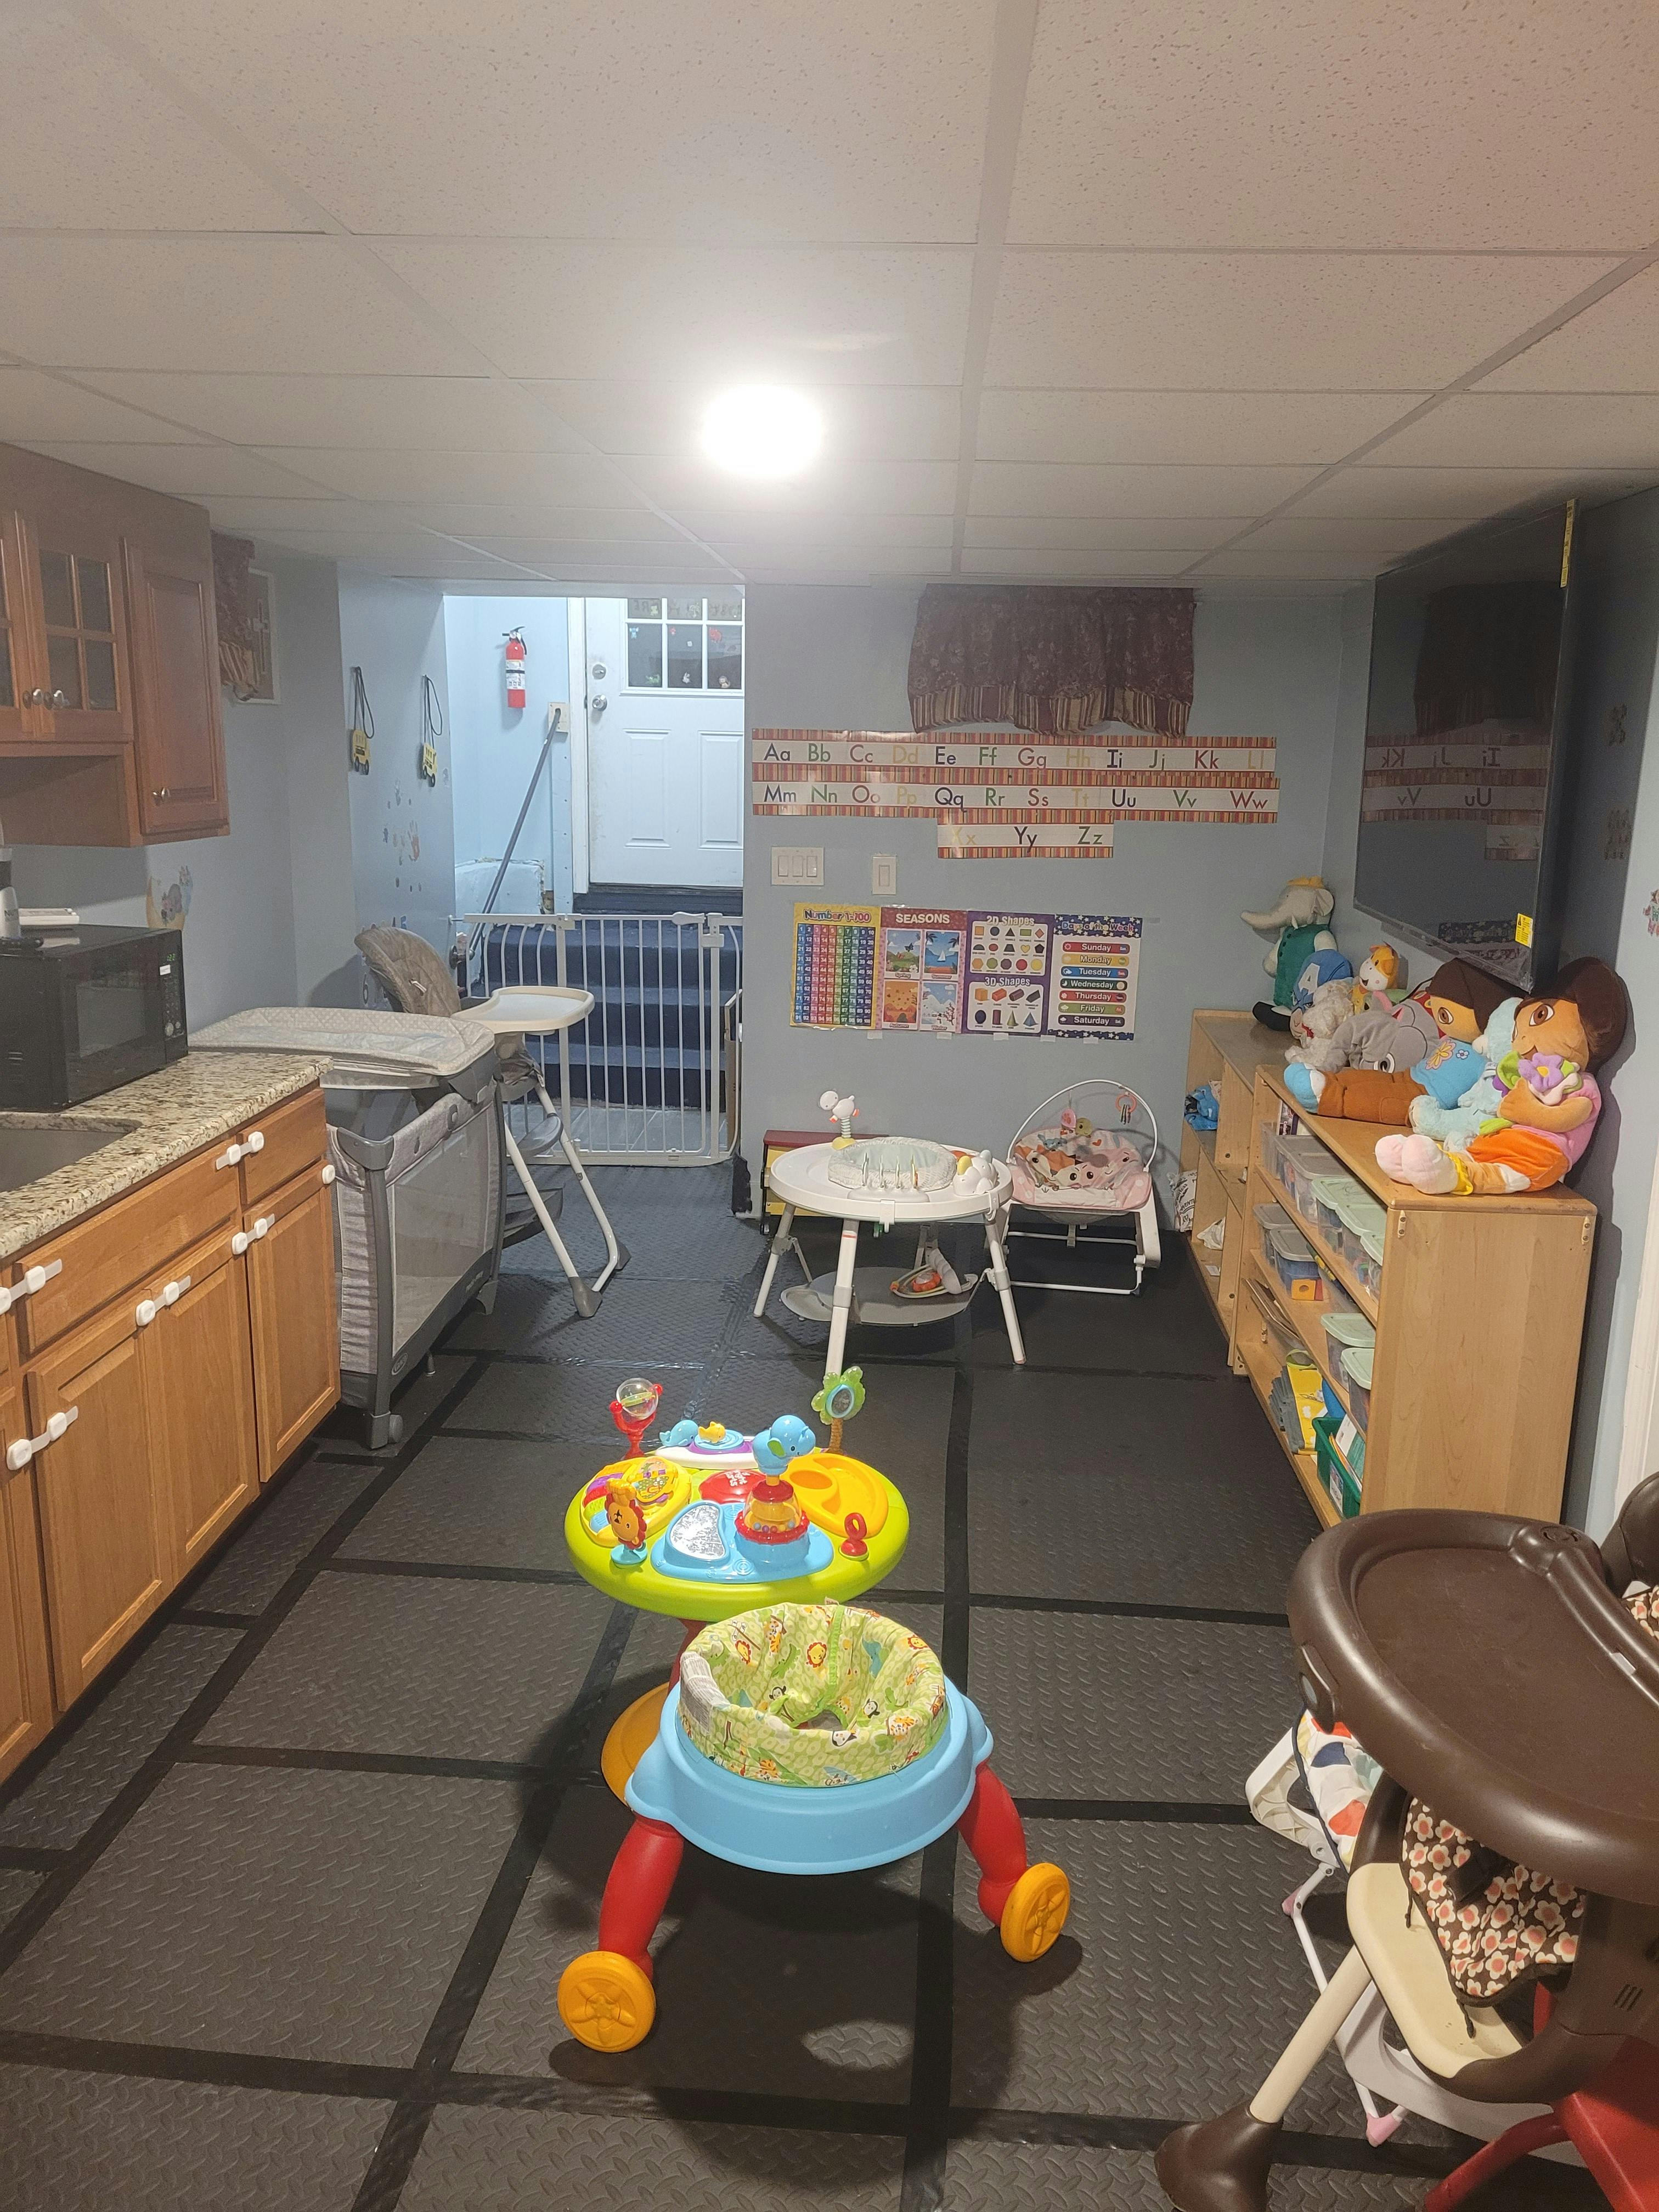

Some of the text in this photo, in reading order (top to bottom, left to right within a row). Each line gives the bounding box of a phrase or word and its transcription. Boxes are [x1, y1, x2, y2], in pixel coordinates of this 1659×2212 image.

[764, 743, 1263, 771] Aa Bb Cc Dd Ee Ff Gg Hh Ii Jj Kk Ll
[764, 785, 1268, 812] Mm Nn Oo Pp Qq Rr Ss Tt Uu Vv Ww
[950, 826, 1103, 853] Xx Yy Zz
[804, 909, 843, 921] Number
[895, 913, 950, 924] SEASONS
[986, 916, 1035, 926] 2D Shapes
[1062, 922, 1083, 931] Days
[1110, 923, 1133, 932] Week
[1081, 944, 1111, 952] Sunday
[1080, 956, 1111, 966] Monday
[1079, 968, 1111, 977] Tuesday
[985, 977, 1030, 988] 3D Shapes
[1298, 962, 1321, 996] A
[1070, 980, 1114, 989] Wednesday
[1075, 992, 1111, 1001] Thursday
[1080, 1005, 1104, 1013] Friday
[1074, 1017, 1109, 1025] Saturday
